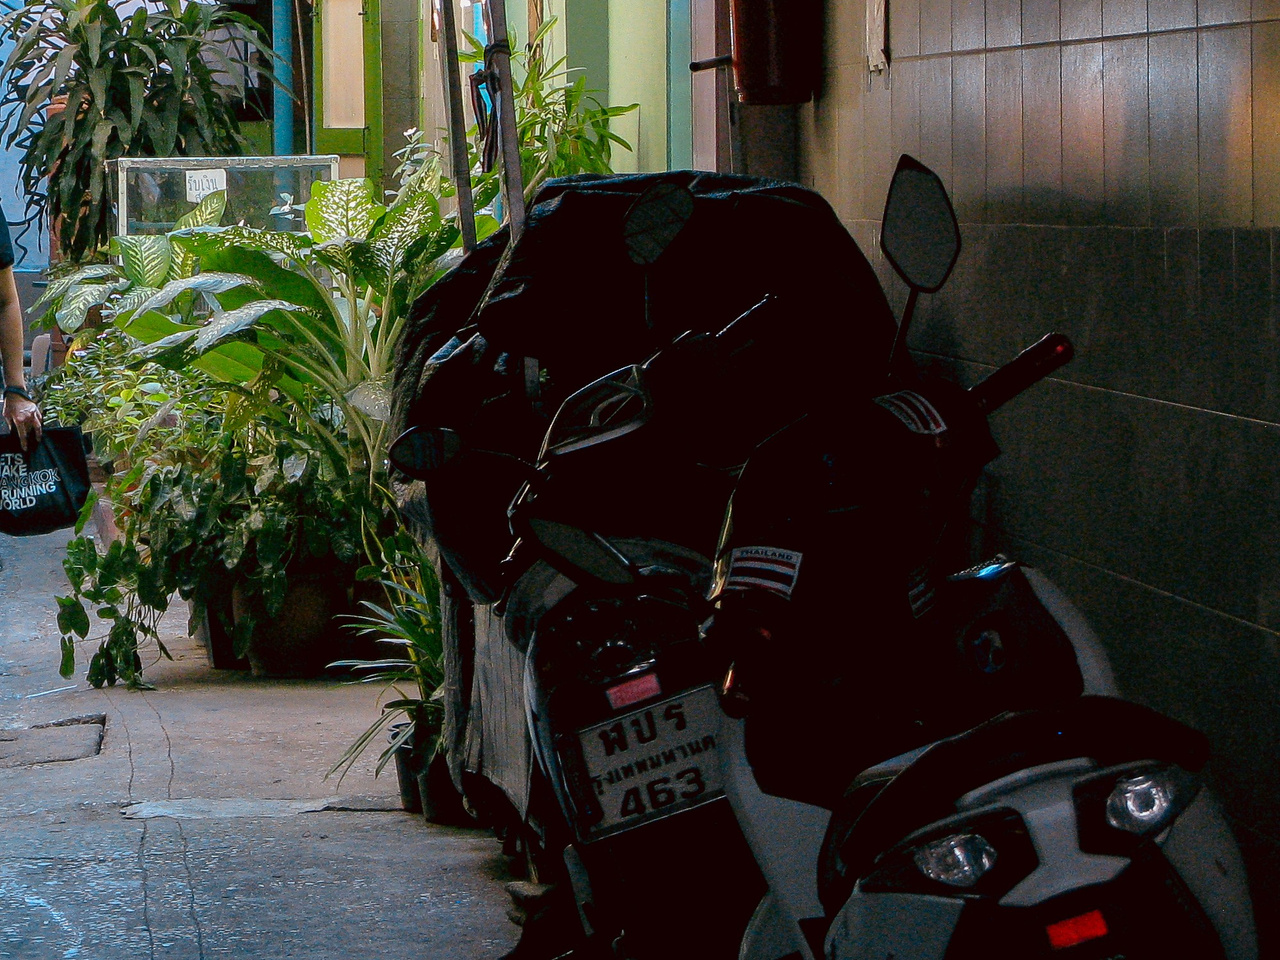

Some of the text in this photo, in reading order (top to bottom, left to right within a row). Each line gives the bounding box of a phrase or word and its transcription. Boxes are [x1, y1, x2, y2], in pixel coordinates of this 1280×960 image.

[1, 481, 57, 501] RUNNING
[740, 549, 793, 561] THAILAND
[620, 766, 706, 818] 463
